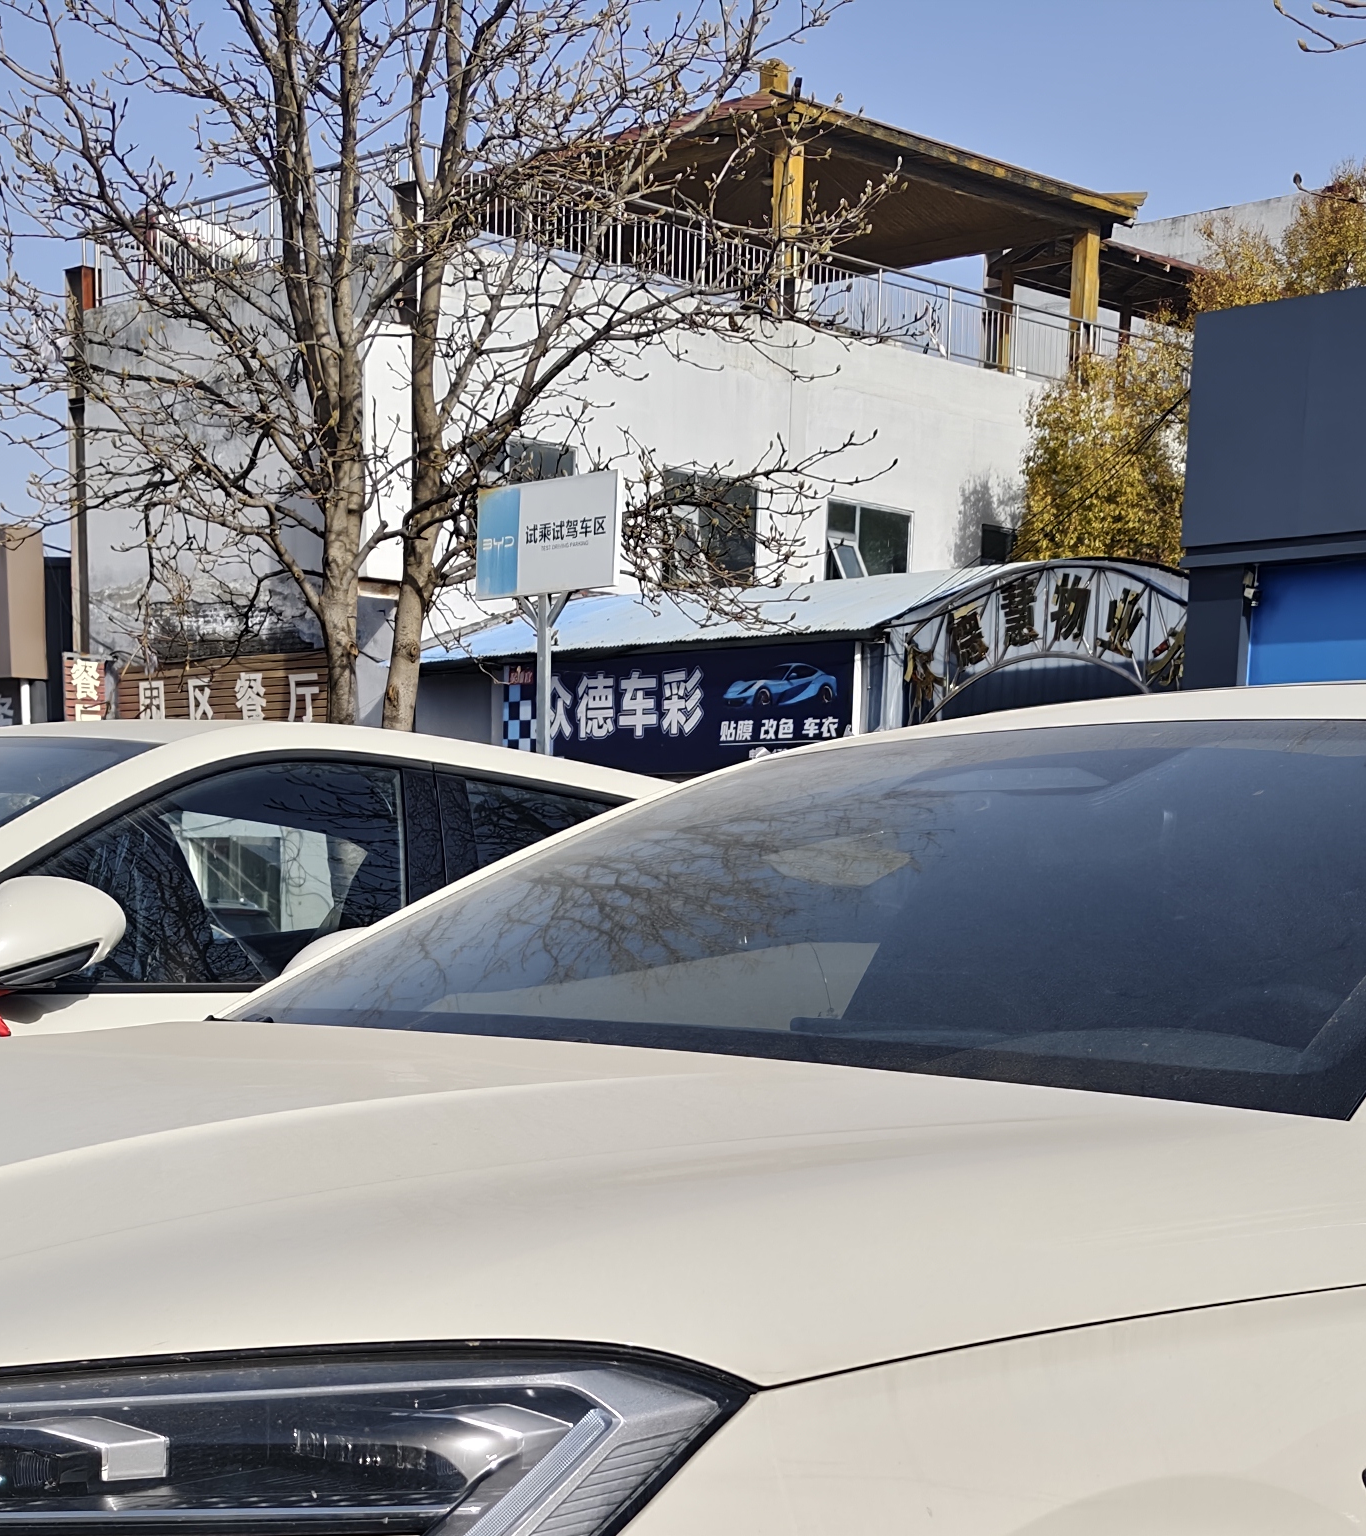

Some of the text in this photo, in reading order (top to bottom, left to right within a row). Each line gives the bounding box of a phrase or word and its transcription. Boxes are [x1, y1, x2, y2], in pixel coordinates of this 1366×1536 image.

[525, 515, 607, 545] 试乘试驾车区
[482, 535, 515, 551] BYD
[720, 716, 839, 741] 贴膜 改色 车衣
